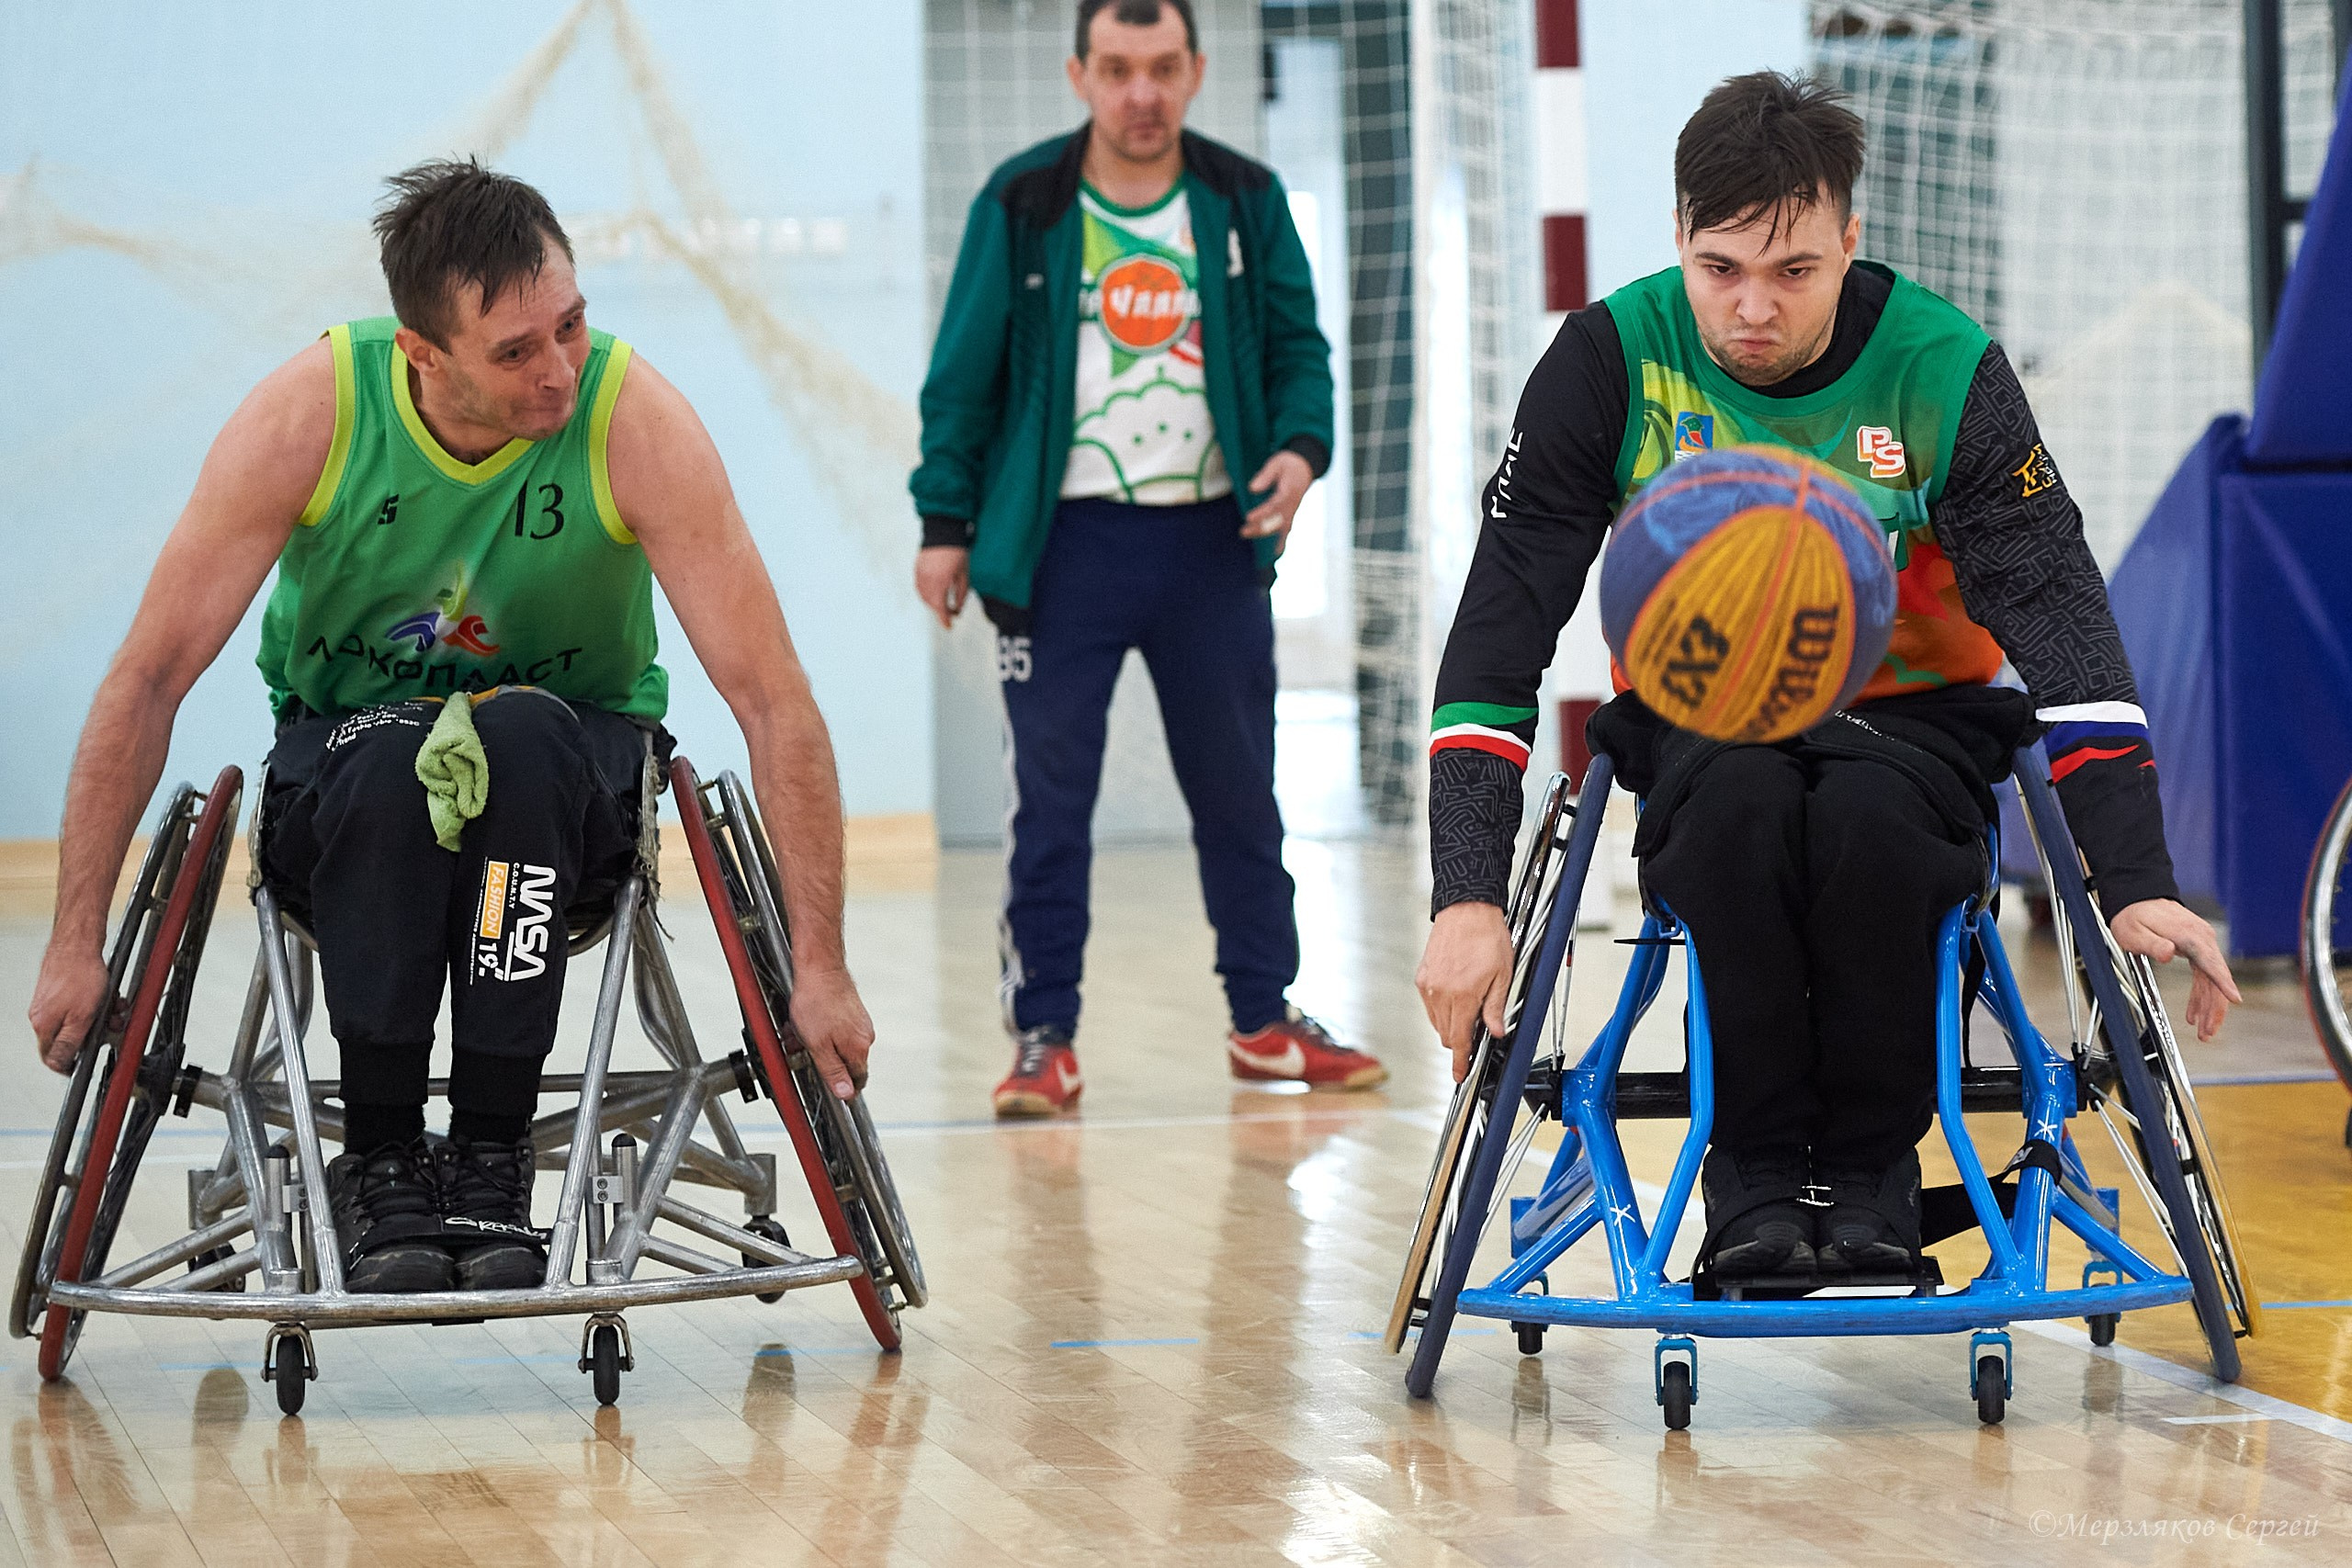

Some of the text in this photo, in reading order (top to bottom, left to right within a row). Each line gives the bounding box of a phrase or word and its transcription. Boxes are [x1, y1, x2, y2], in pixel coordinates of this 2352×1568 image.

[514, 479, 564, 539] 13
[486, 865, 505, 935] FASHION
[510, 863, 557, 981] NASA
